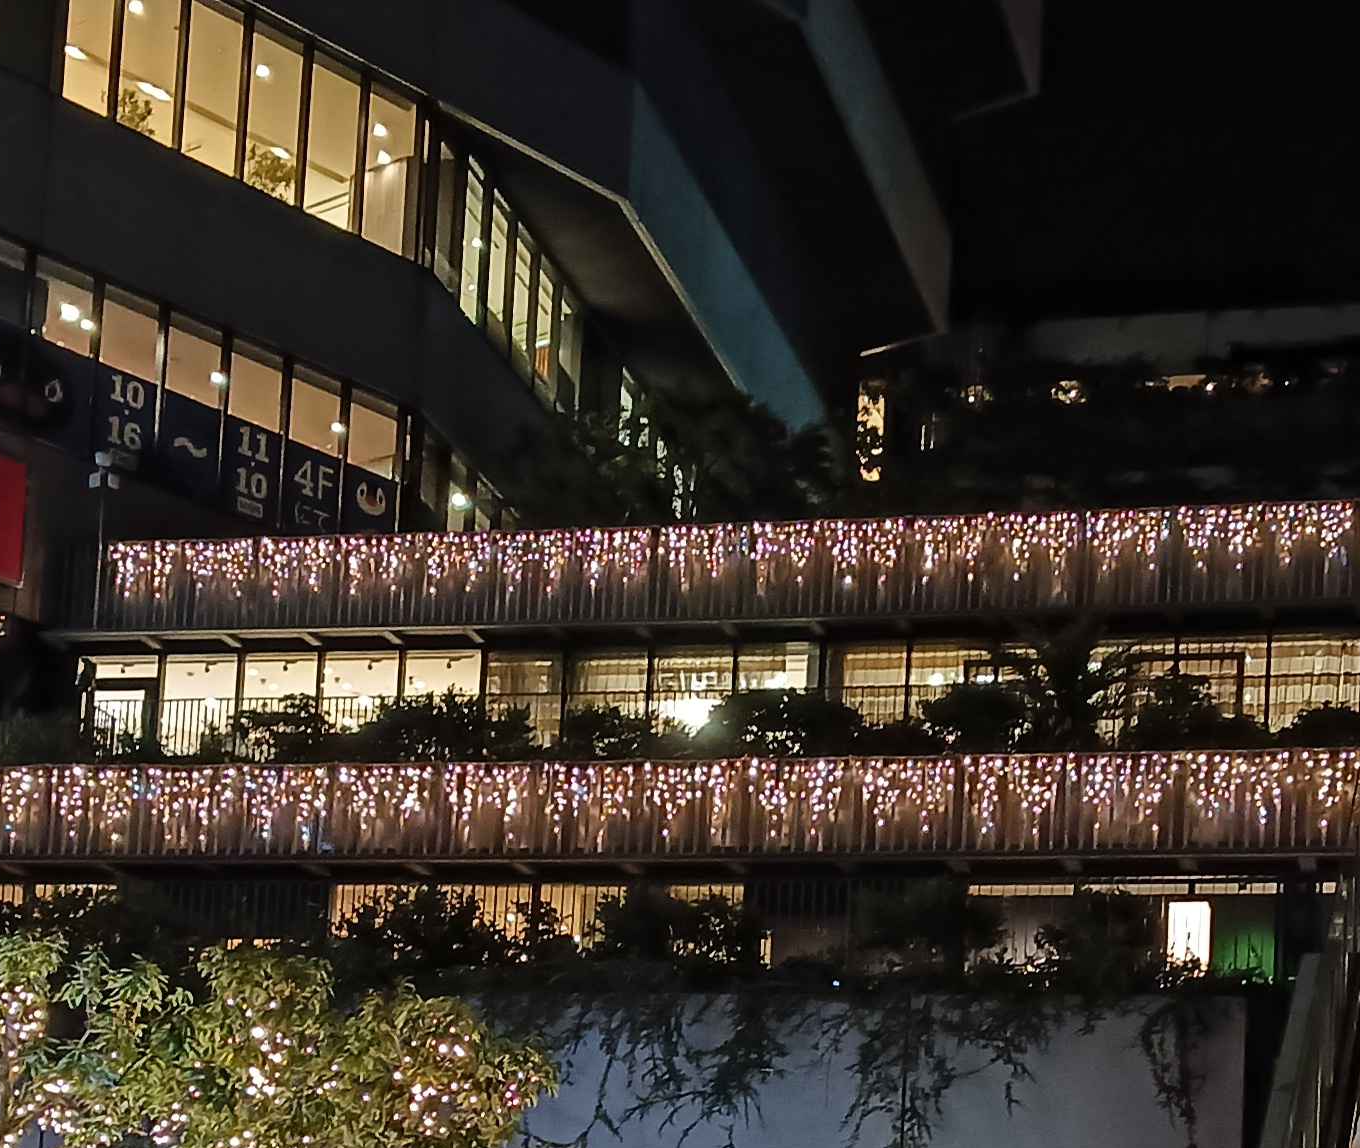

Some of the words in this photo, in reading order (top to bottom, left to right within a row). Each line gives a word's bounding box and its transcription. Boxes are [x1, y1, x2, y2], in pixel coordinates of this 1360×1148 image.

[109, 374, 145, 410] 10
[107, 416, 142, 450] 16
[238, 425, 271, 464] 11
[235, 466, 268, 500] 10
[293, 459, 336, 500] 4F
